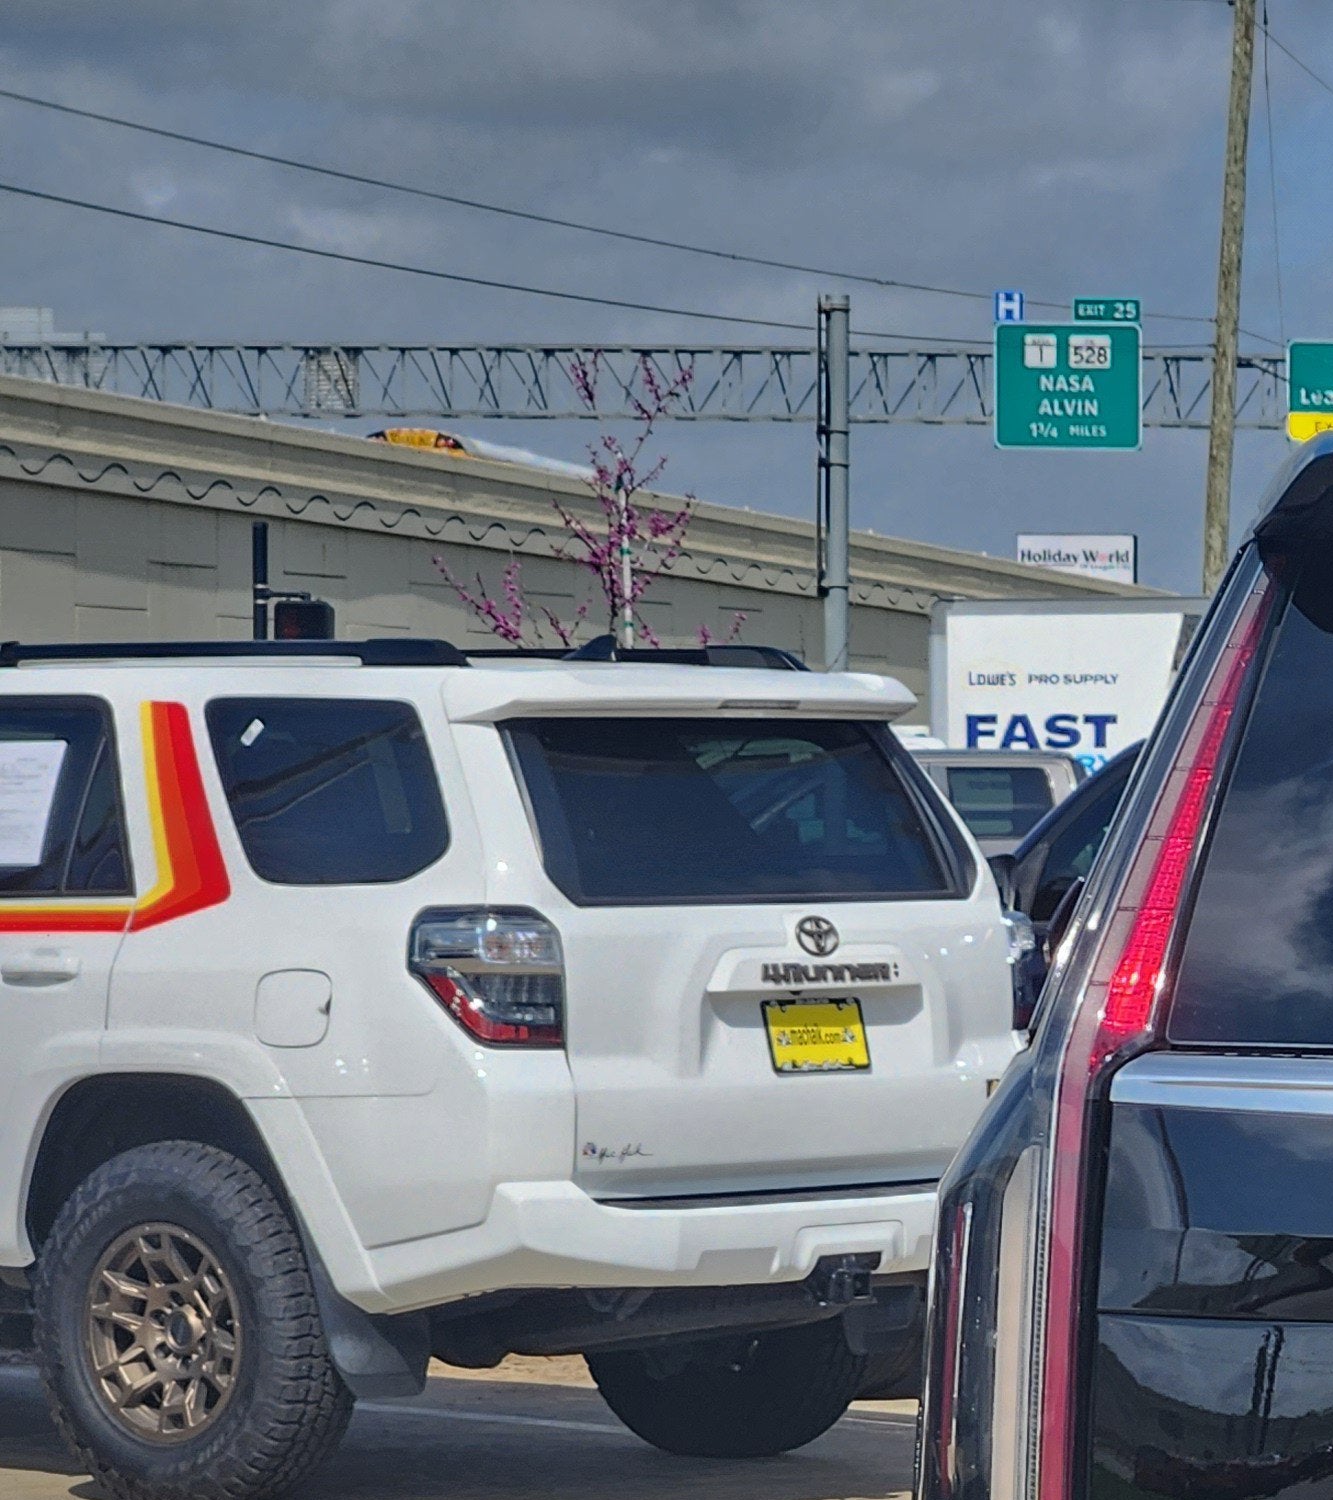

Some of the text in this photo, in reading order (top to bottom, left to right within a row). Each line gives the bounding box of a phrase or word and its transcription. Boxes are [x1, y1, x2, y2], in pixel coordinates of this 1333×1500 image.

[1078, 302, 1136, 318] EXIT 25
[1073, 346, 1108, 364] 528
[1040, 374, 1095, 392] NASA
[1038, 398, 1099, 416] ALVIN
[1069, 425, 1107, 437] MILES
[1020, 549, 1130, 563] Holiday World
[968, 671, 1119, 686] LOWE'S PRO SUPPLY
[966, 714, 1117, 749] FAST
